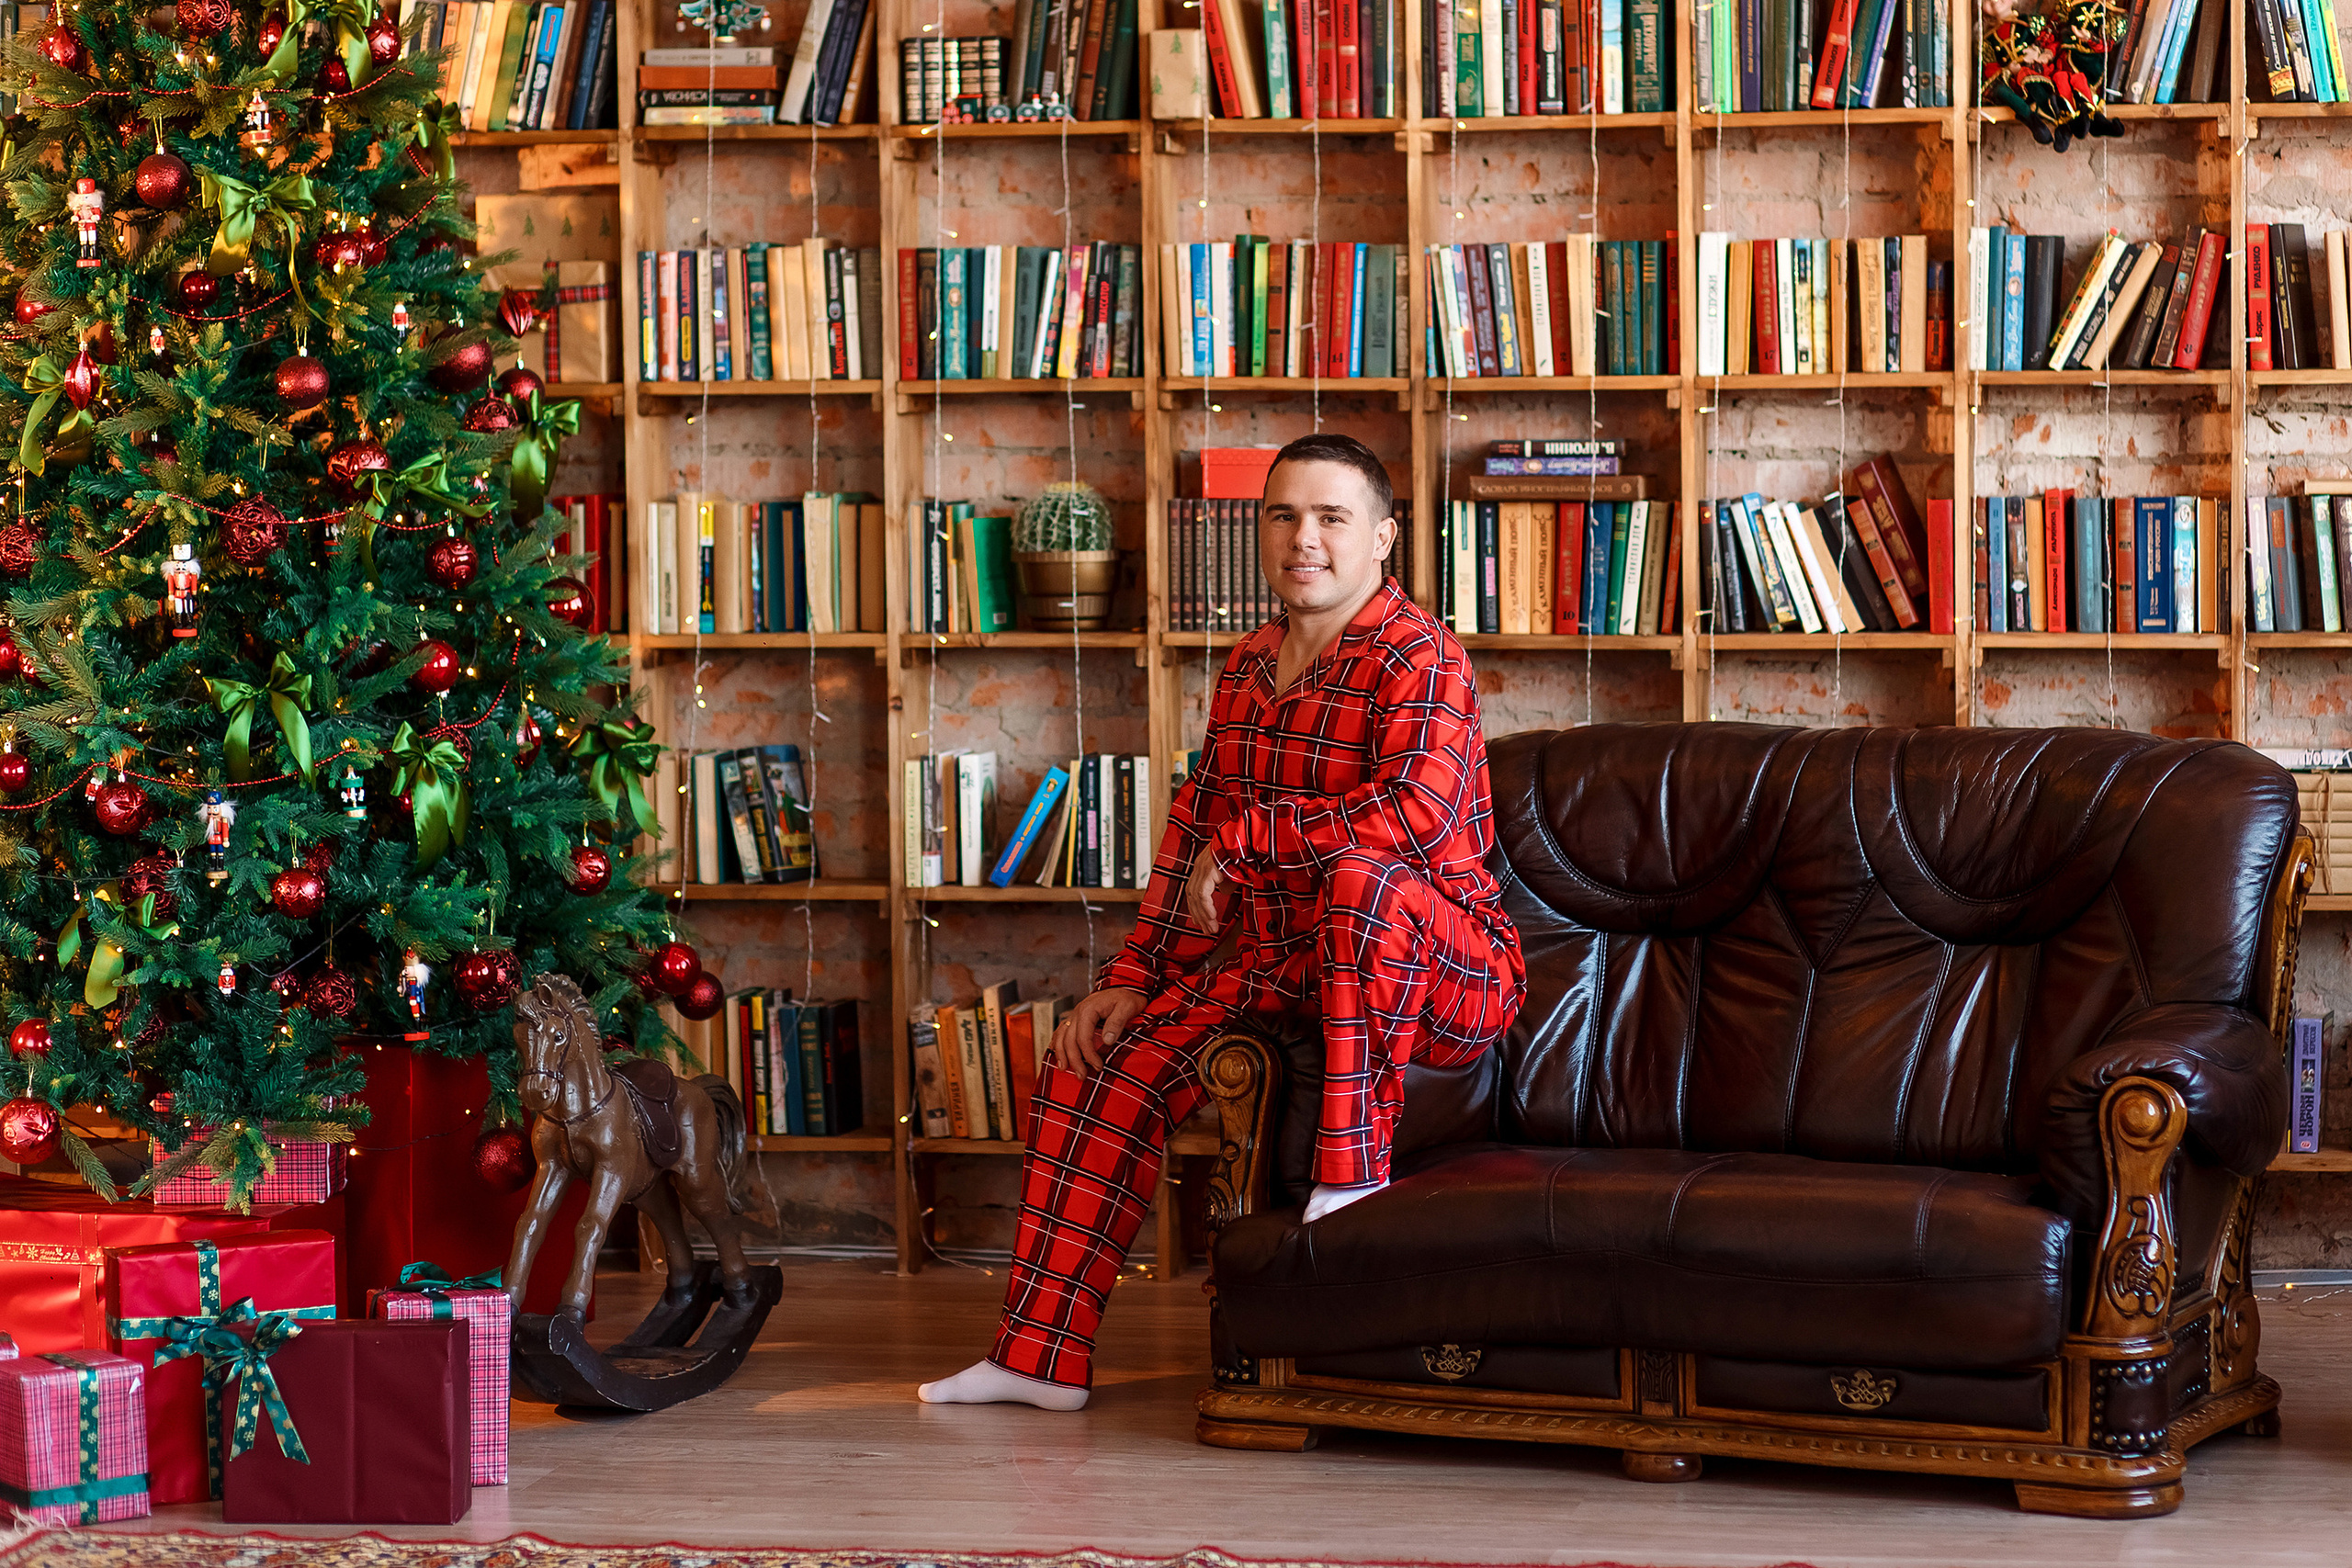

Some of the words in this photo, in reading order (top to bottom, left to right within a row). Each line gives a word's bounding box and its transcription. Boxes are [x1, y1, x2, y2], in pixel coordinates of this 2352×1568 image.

[2253, 246, 2262, 288] РУДЕНКО
[2254, 310, 2265, 338] Борис
[1545, 442, 1600, 455] ПРОНИН
[1477, 484, 1518, 494] СЛОВАРЬ
[1509, 514, 1519, 545] ПОЯС
[1538, 516, 1548, 547] ПОЯС
[2050, 510, 2058, 555] МАРИНИНА
[1508, 547, 1520, 607] КАМЕННЫЙ
[1537, 549, 1548, 609] КАМЕННЫЙ
[1563, 610, 1575, 621] 10
[988, 1008, 998, 1046] ШКОЛА
[2305, 1095, 2315, 1138] ВОРОН
